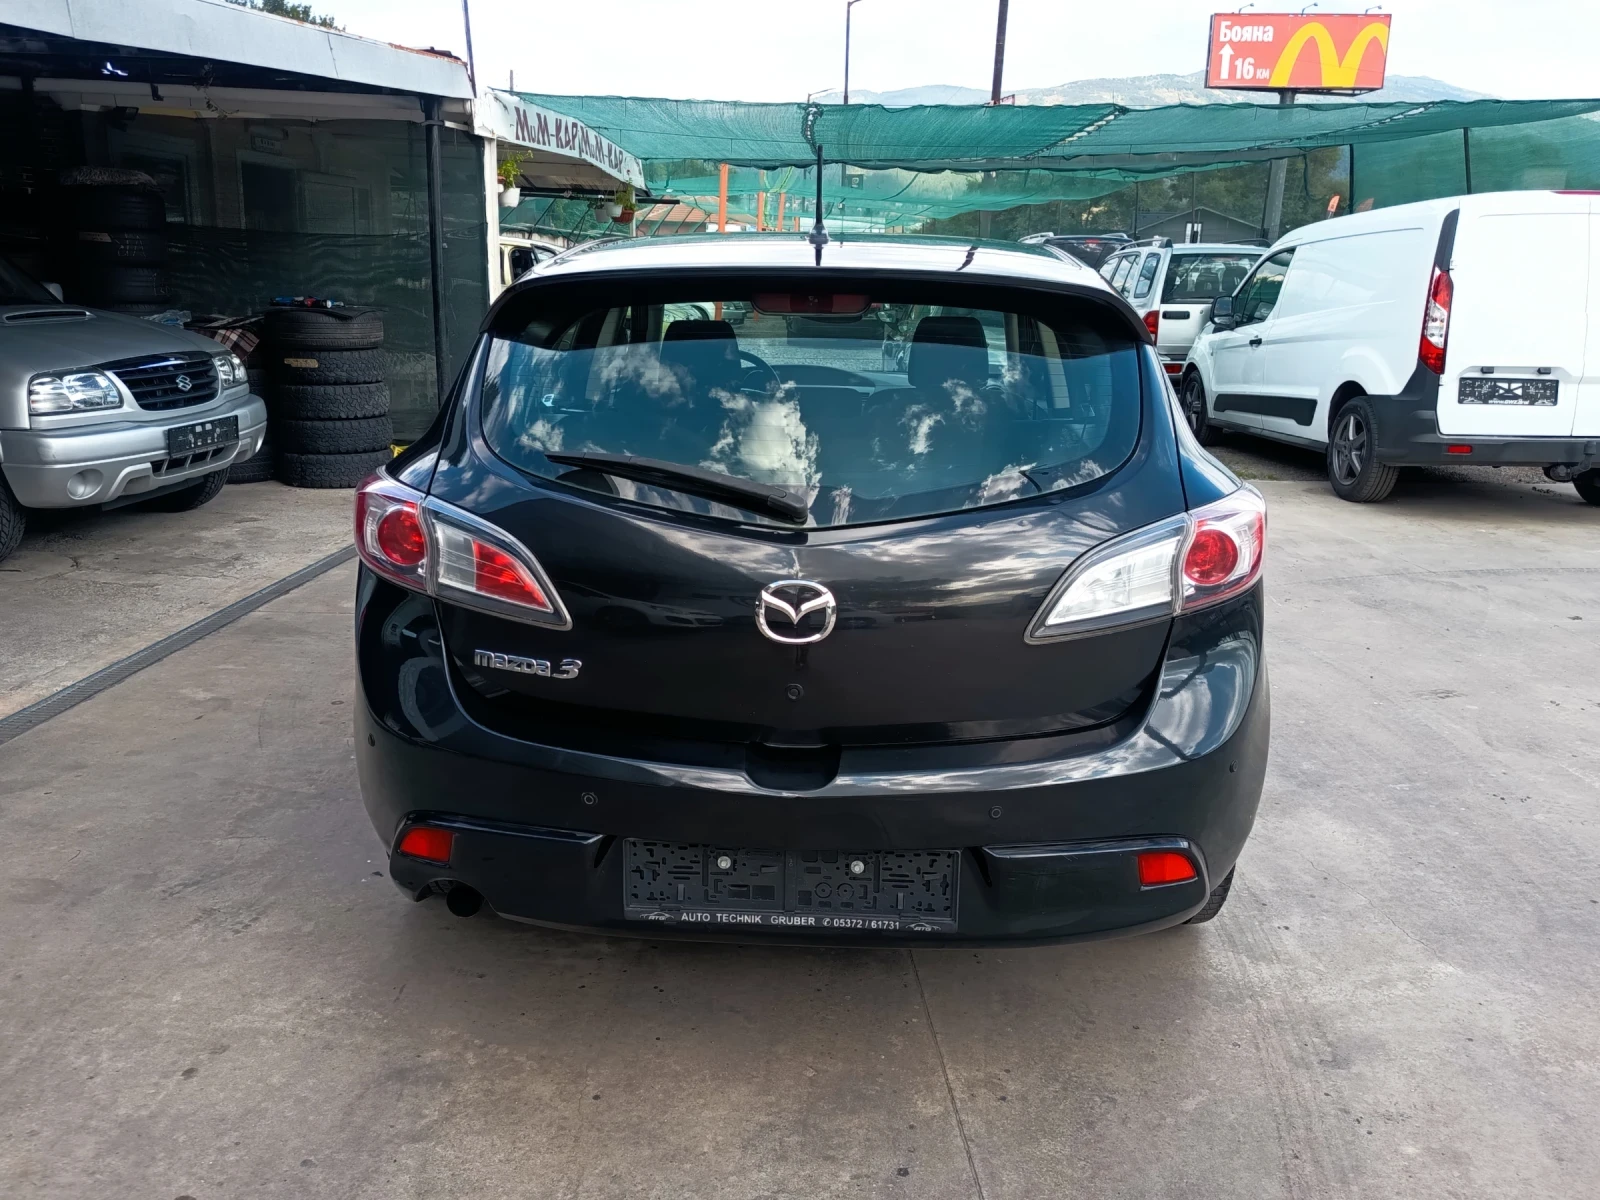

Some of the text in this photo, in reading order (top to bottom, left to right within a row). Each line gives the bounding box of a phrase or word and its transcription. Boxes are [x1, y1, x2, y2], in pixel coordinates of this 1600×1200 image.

[1219, 21, 1274, 43] Бояна
[1234, 57, 1255, 80] 16
[681, 913, 711, 922] AUTO
[716, 913, 762, 924] TECHNIK
[770, 916, 816, 926] GRUBER
[833, 919, 863, 928] 05372
[871, 920, 900, 930] 61731
